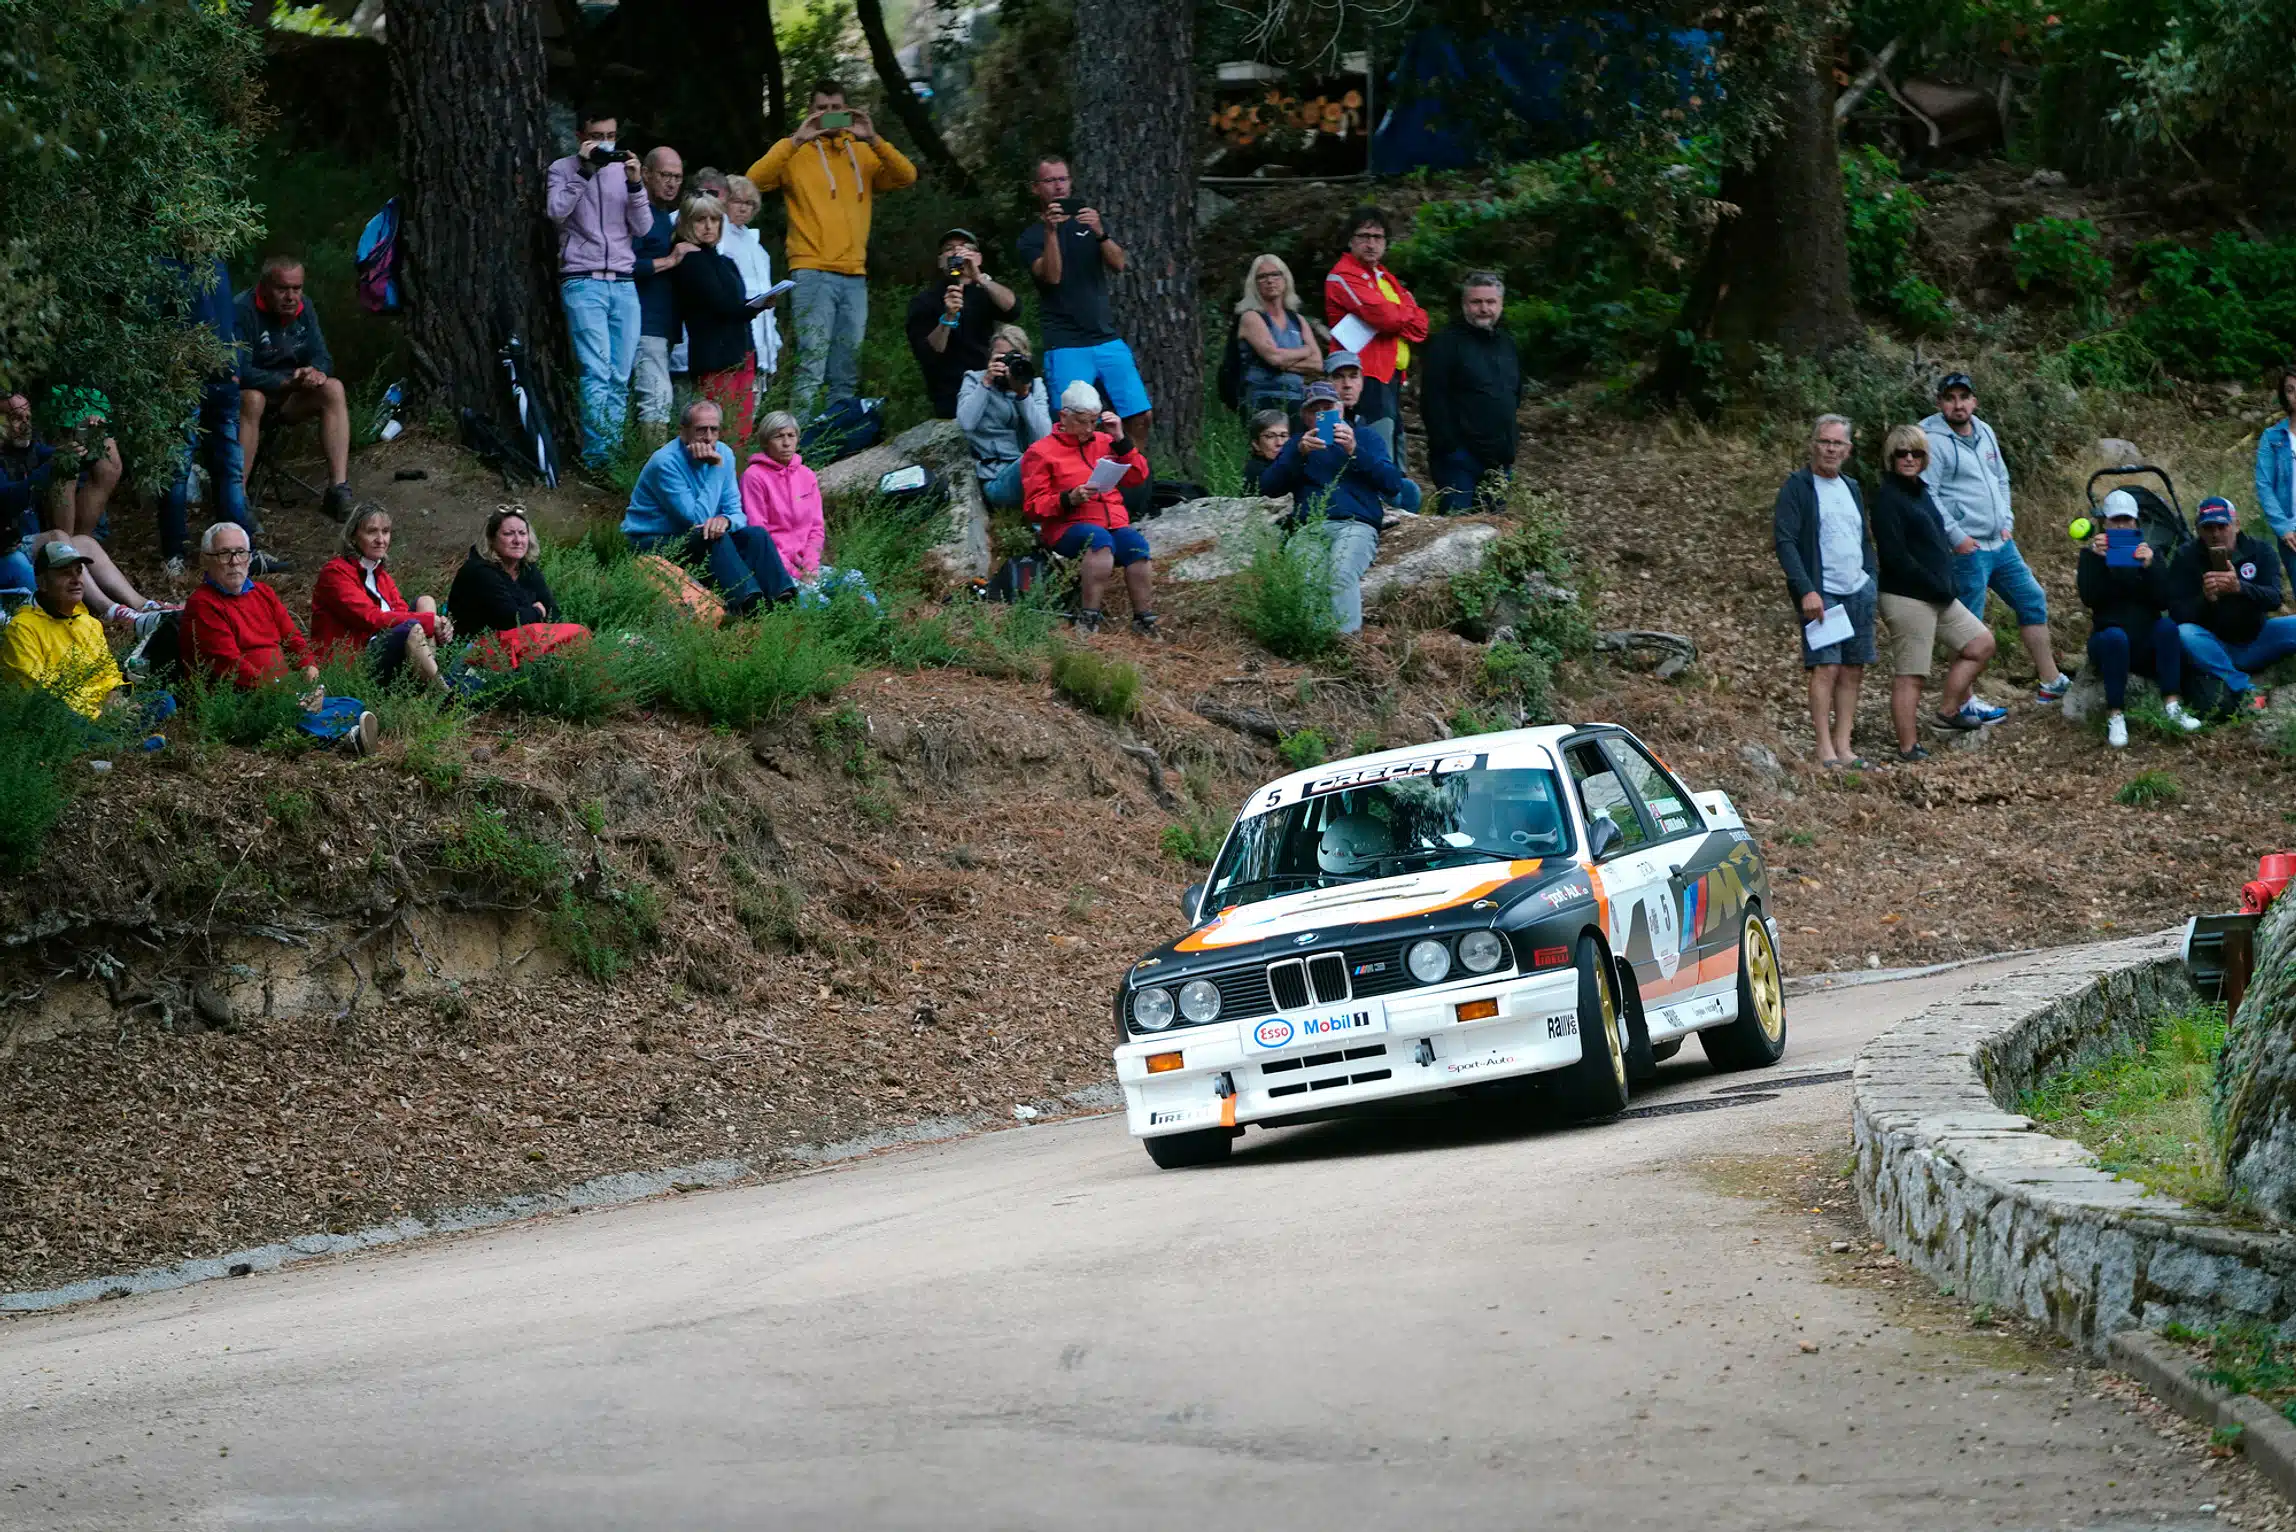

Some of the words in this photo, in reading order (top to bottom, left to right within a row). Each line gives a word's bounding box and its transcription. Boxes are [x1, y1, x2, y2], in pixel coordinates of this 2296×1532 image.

[1265, 789, 1283, 807] 5
[1660, 894, 1671, 932] 5
[1260, 1027, 1289, 1040] Esso
[1303, 1014, 1351, 1035] Mobil
[1354, 1012, 1369, 1027] 1
